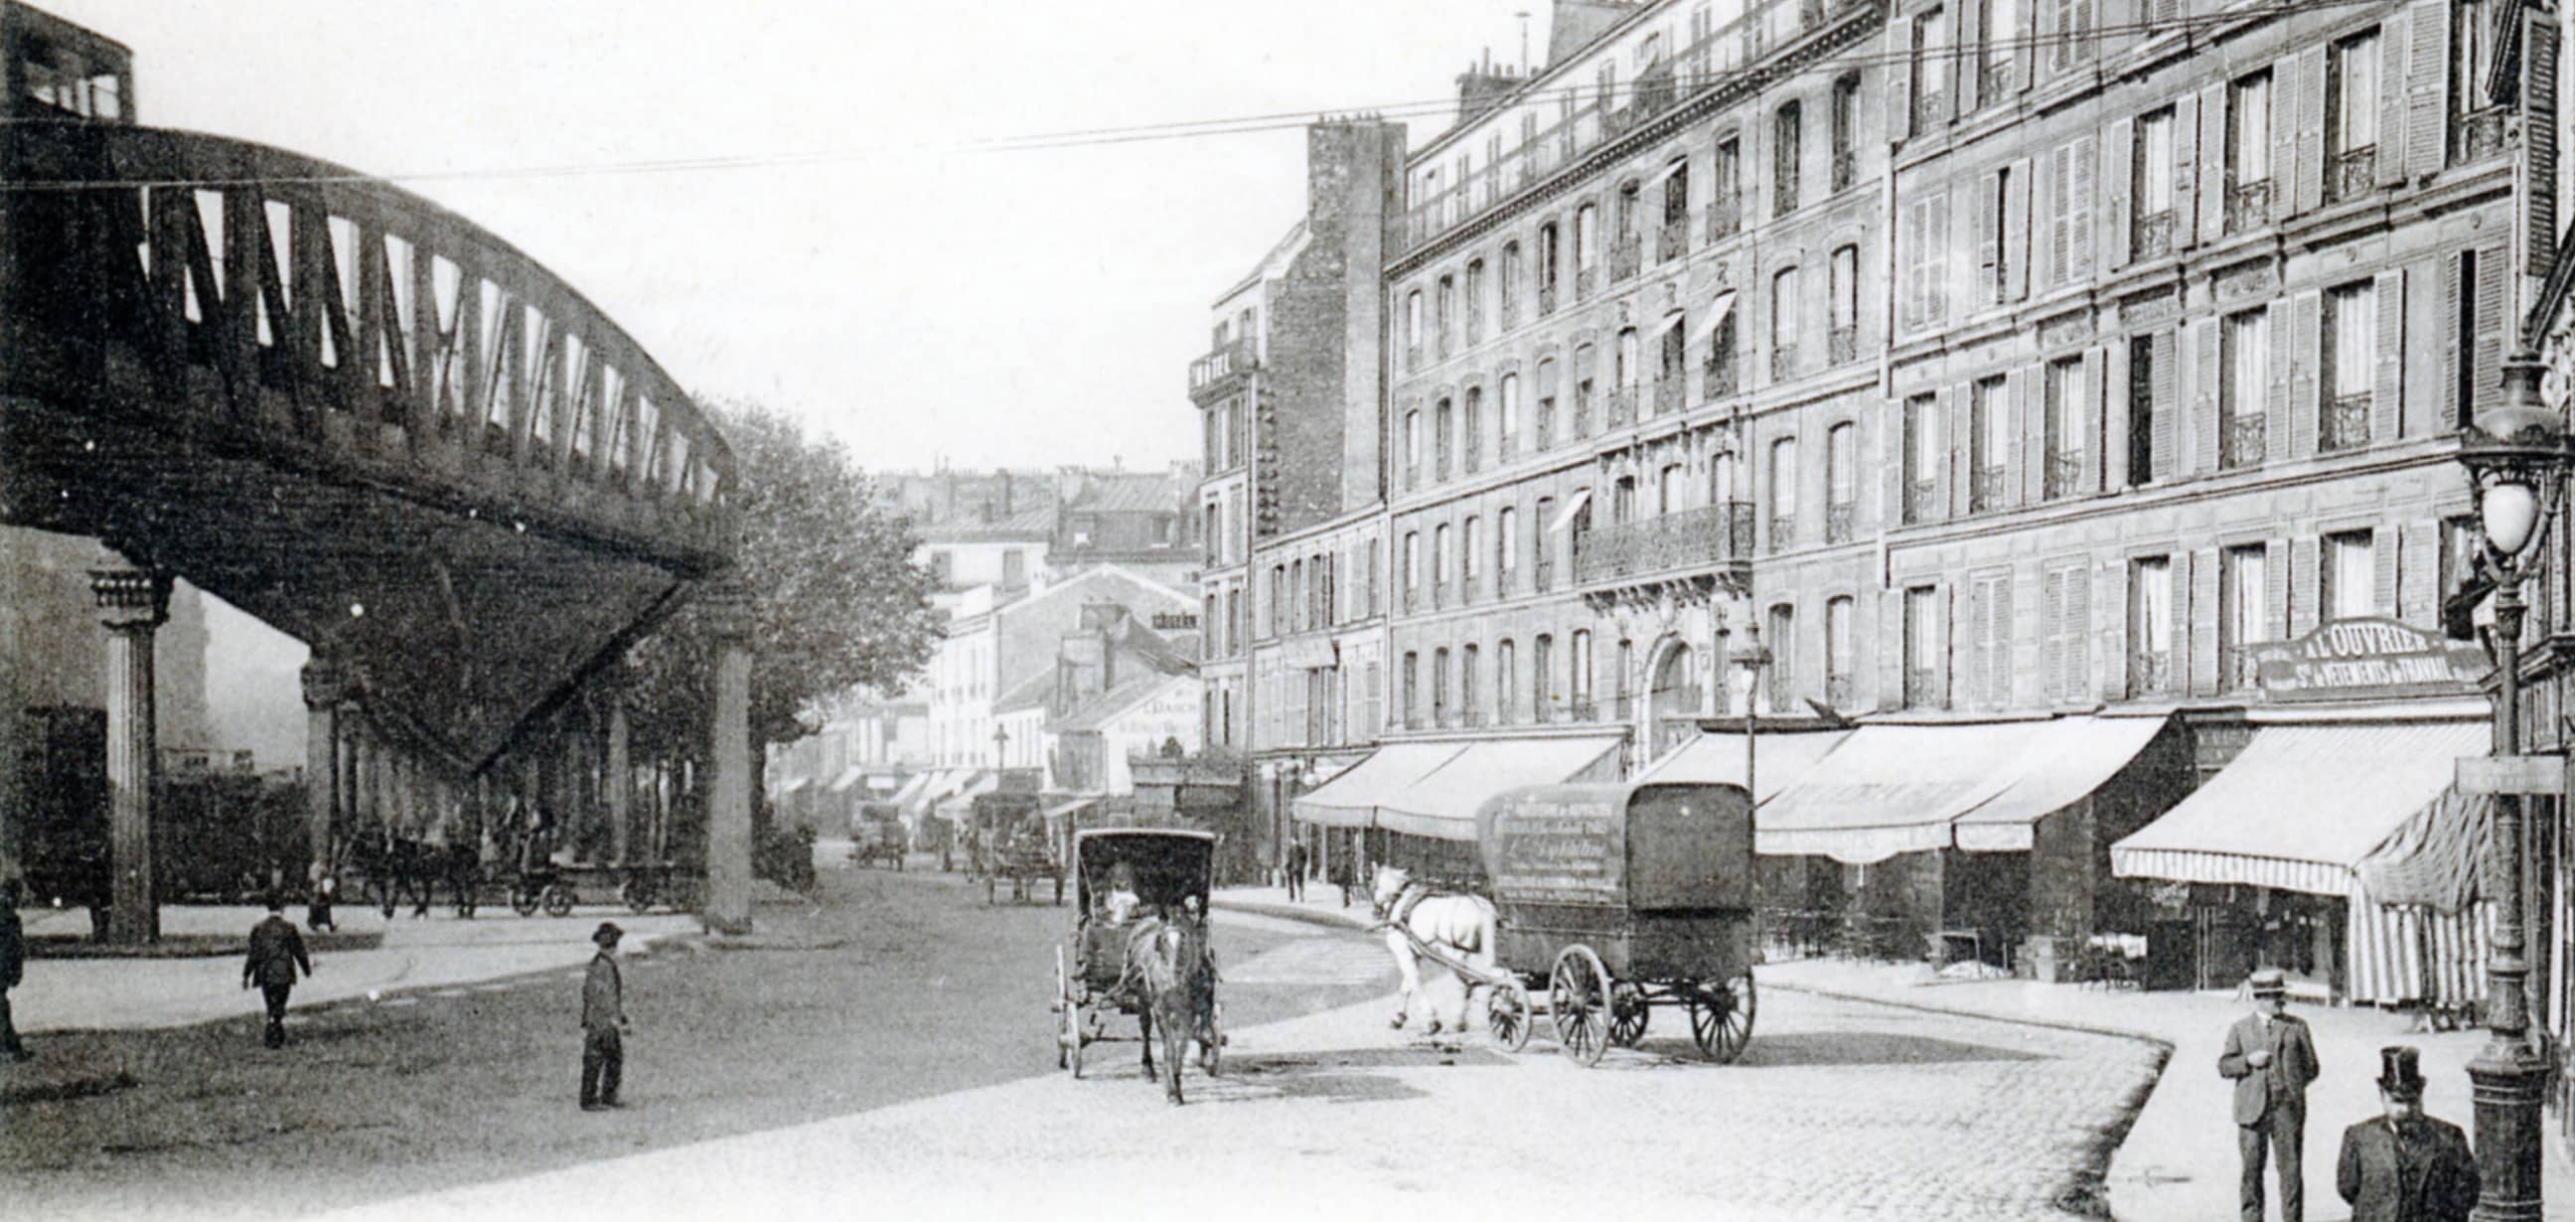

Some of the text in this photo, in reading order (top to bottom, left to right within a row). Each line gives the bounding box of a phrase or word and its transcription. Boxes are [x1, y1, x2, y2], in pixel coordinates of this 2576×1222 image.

[2306, 642, 2317, 658] A
[2316, 623, 2429, 657] L'OUVRIER
[2397, 658, 2453, 683] TRAVAIL
